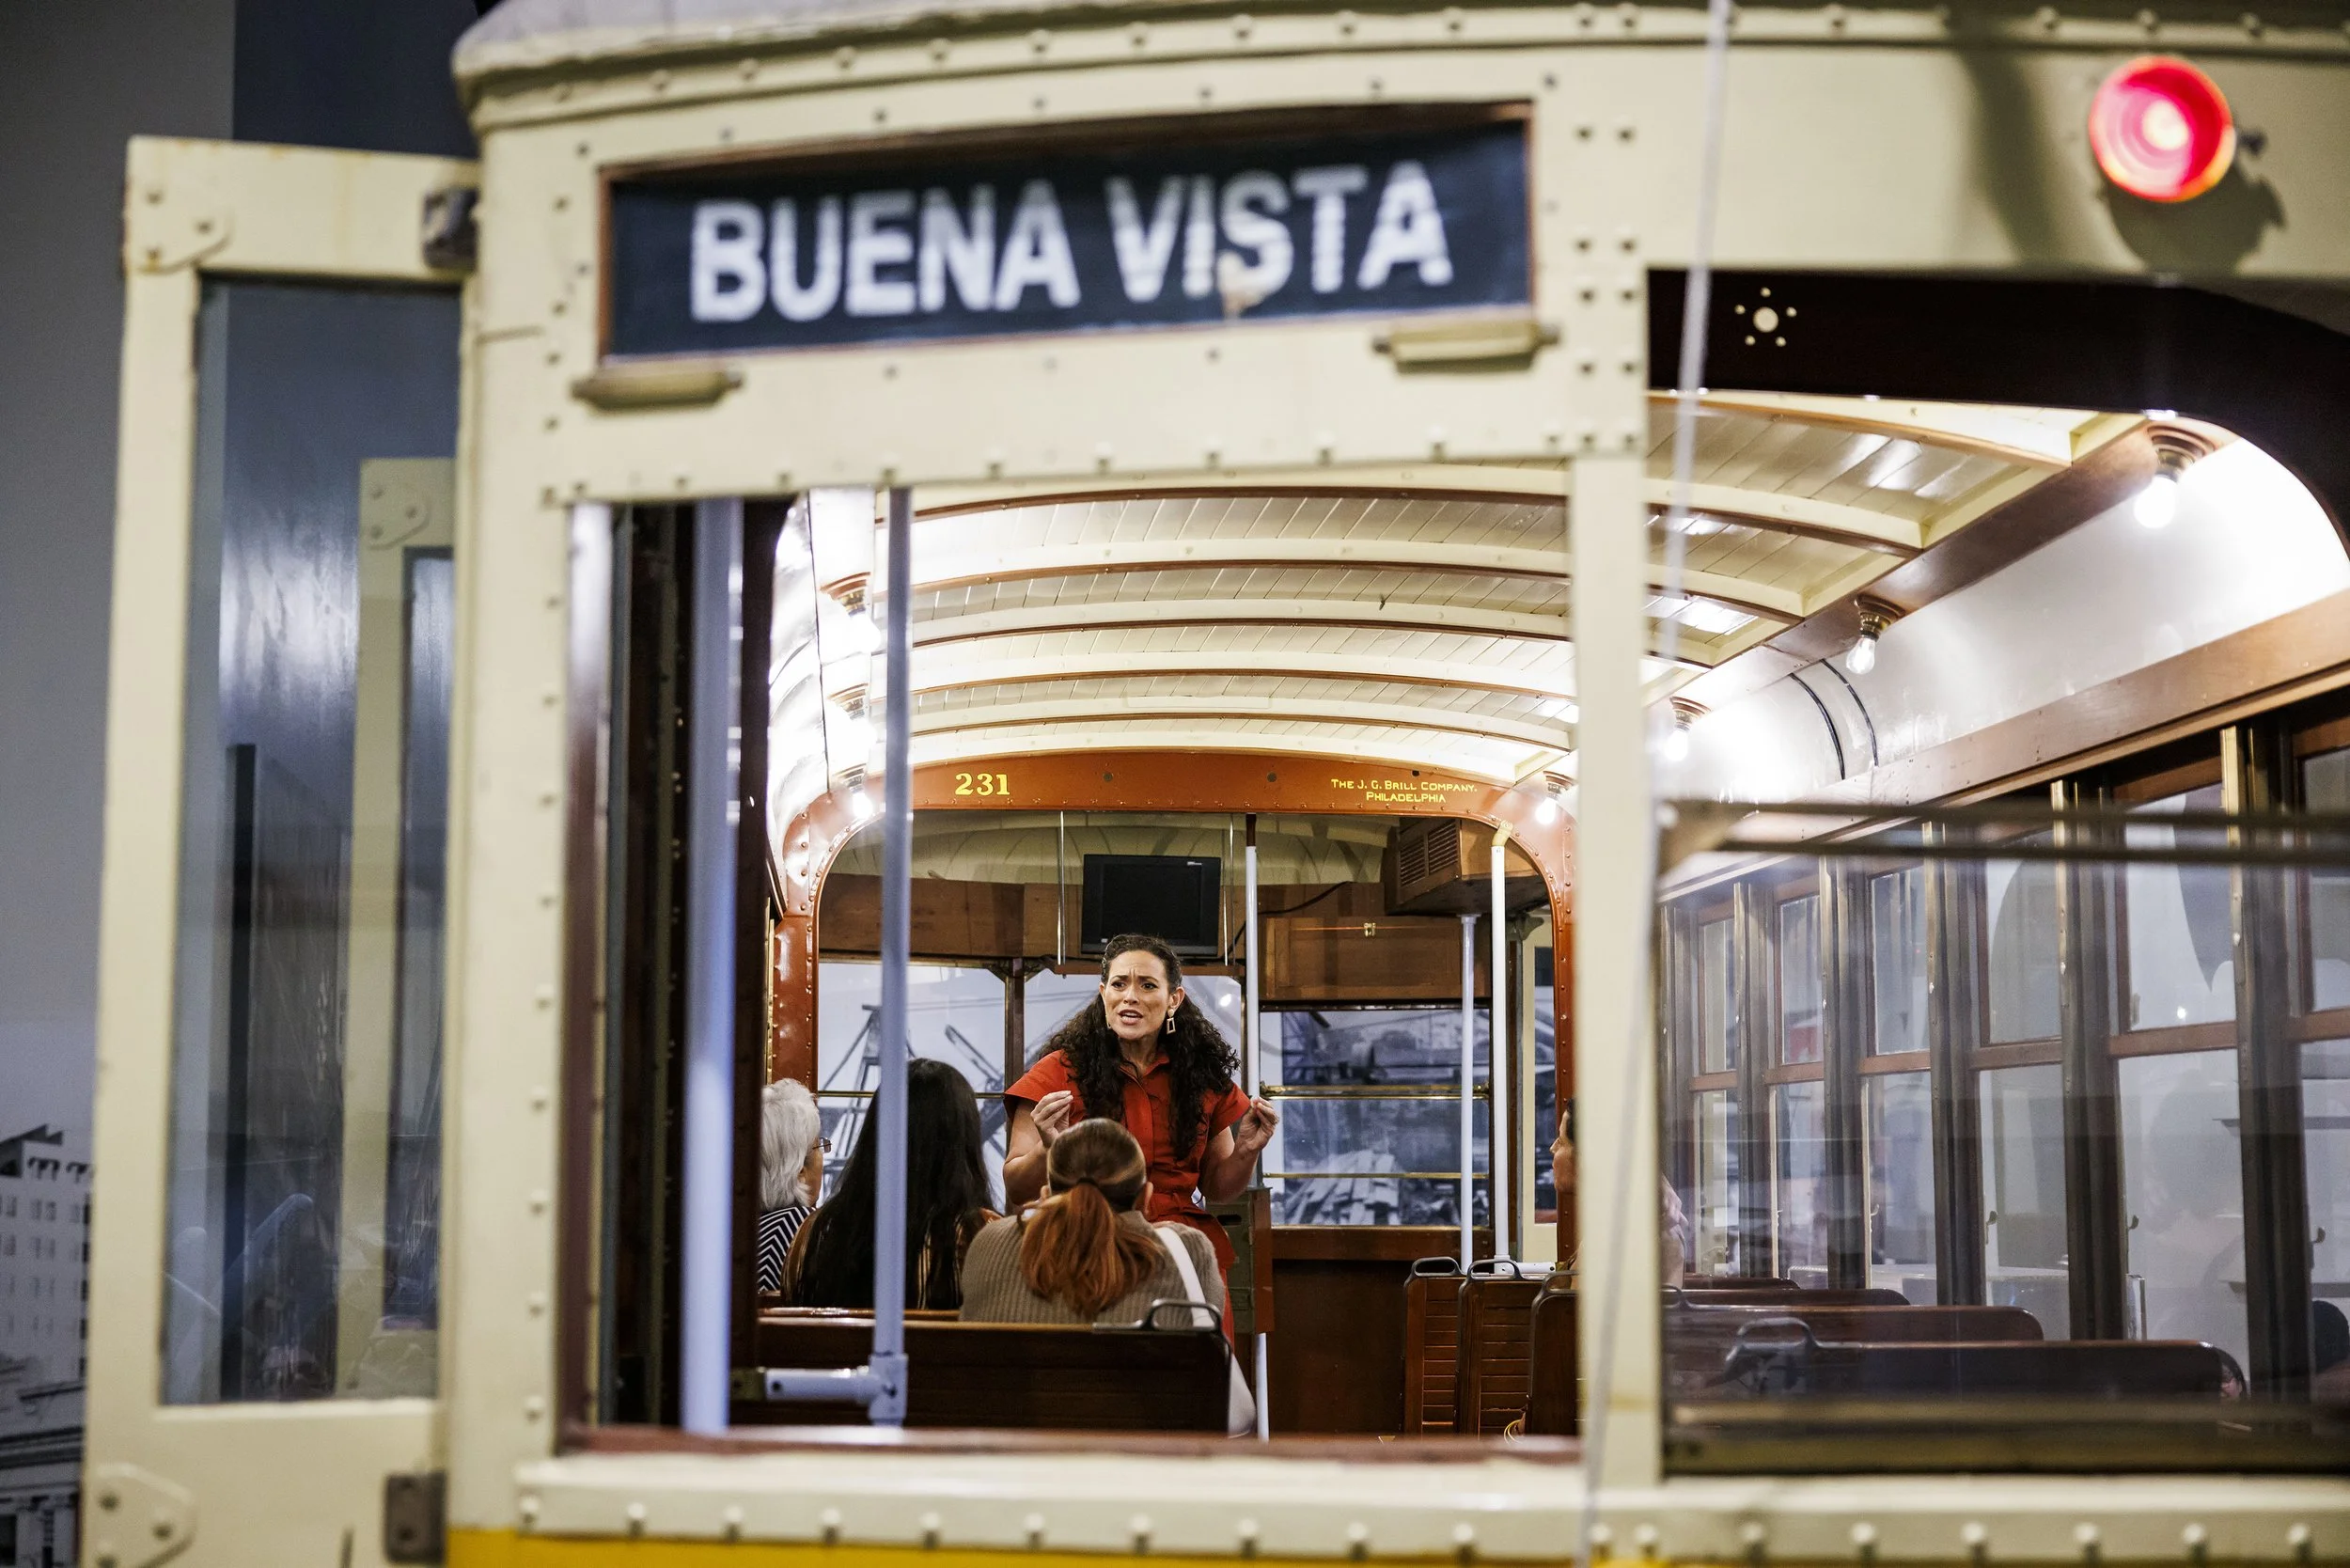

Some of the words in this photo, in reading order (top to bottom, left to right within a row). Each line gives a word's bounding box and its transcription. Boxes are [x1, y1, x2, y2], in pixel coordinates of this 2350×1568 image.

[690, 181, 1081, 321] BUENA
[1106, 162, 1453, 304] VISTA
[955, 773, 1010, 795] 231
[1371, 780, 1382, 790] G.
[1385, 780, 1418, 791] BRILL
[1366, 792, 1447, 803] PHILADELPHIA
